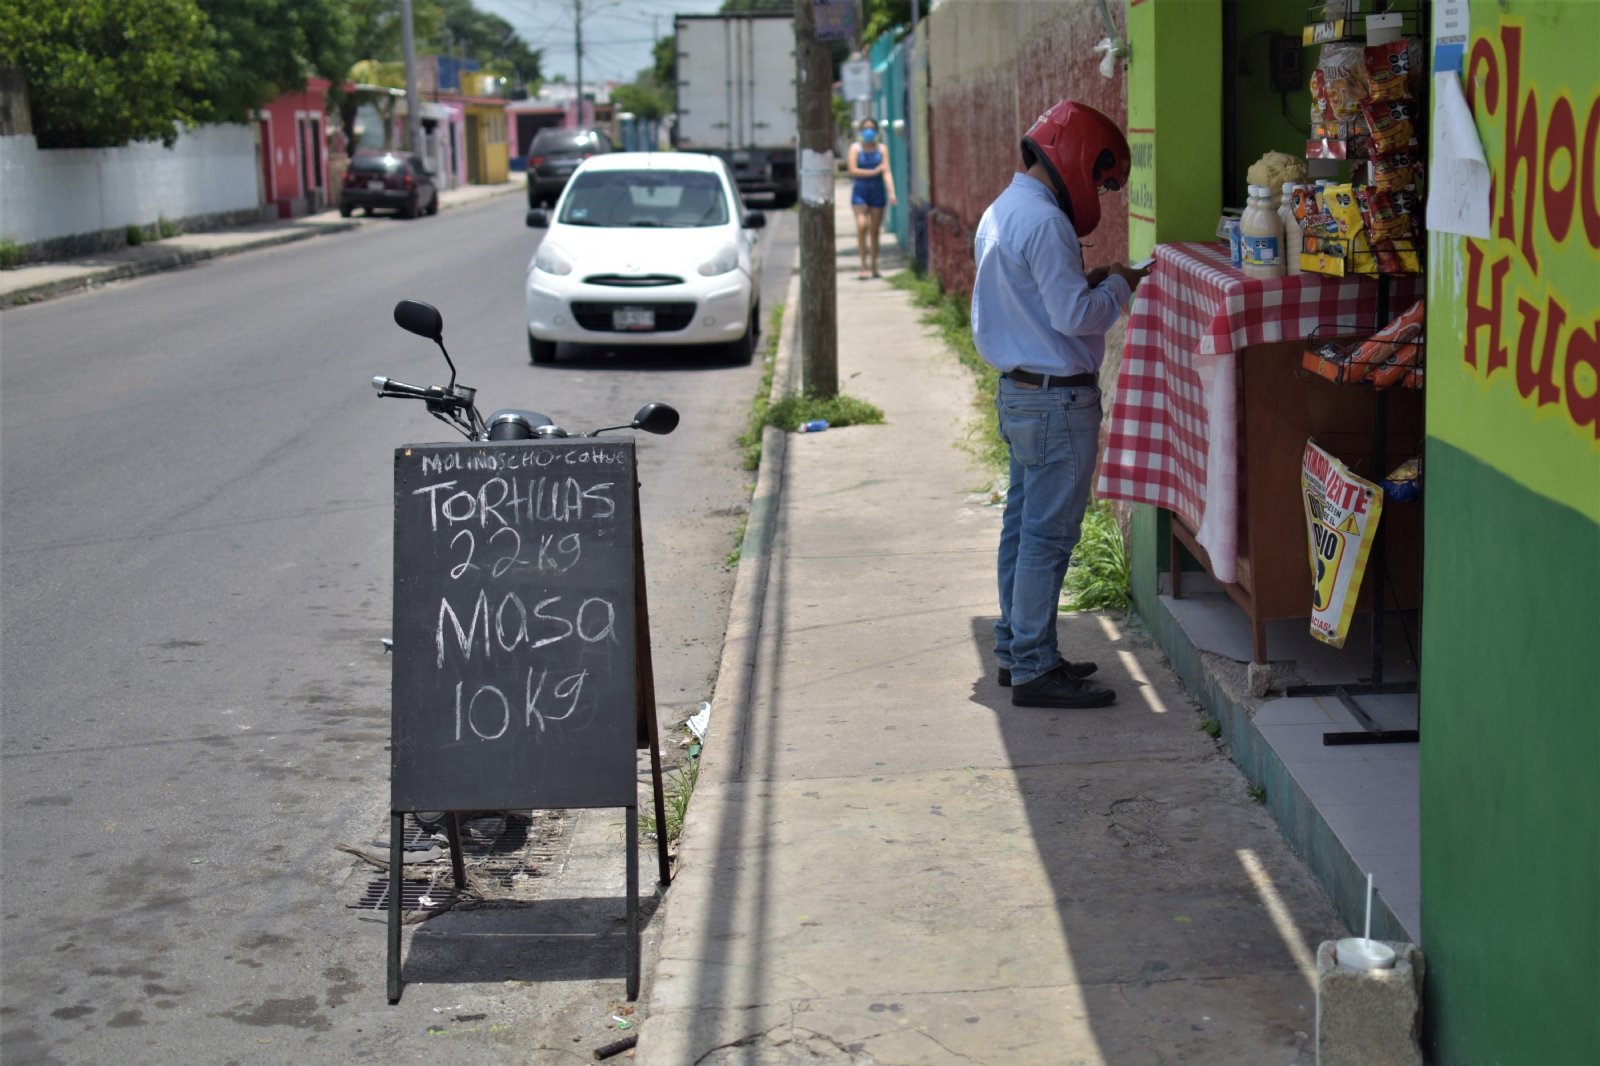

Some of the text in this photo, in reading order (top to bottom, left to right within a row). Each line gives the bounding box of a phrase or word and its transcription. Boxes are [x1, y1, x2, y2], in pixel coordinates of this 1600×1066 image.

[412, 476, 616, 532] TORTILLAS
[450, 526, 530, 579] 22
[455, 680, 510, 741] 10
